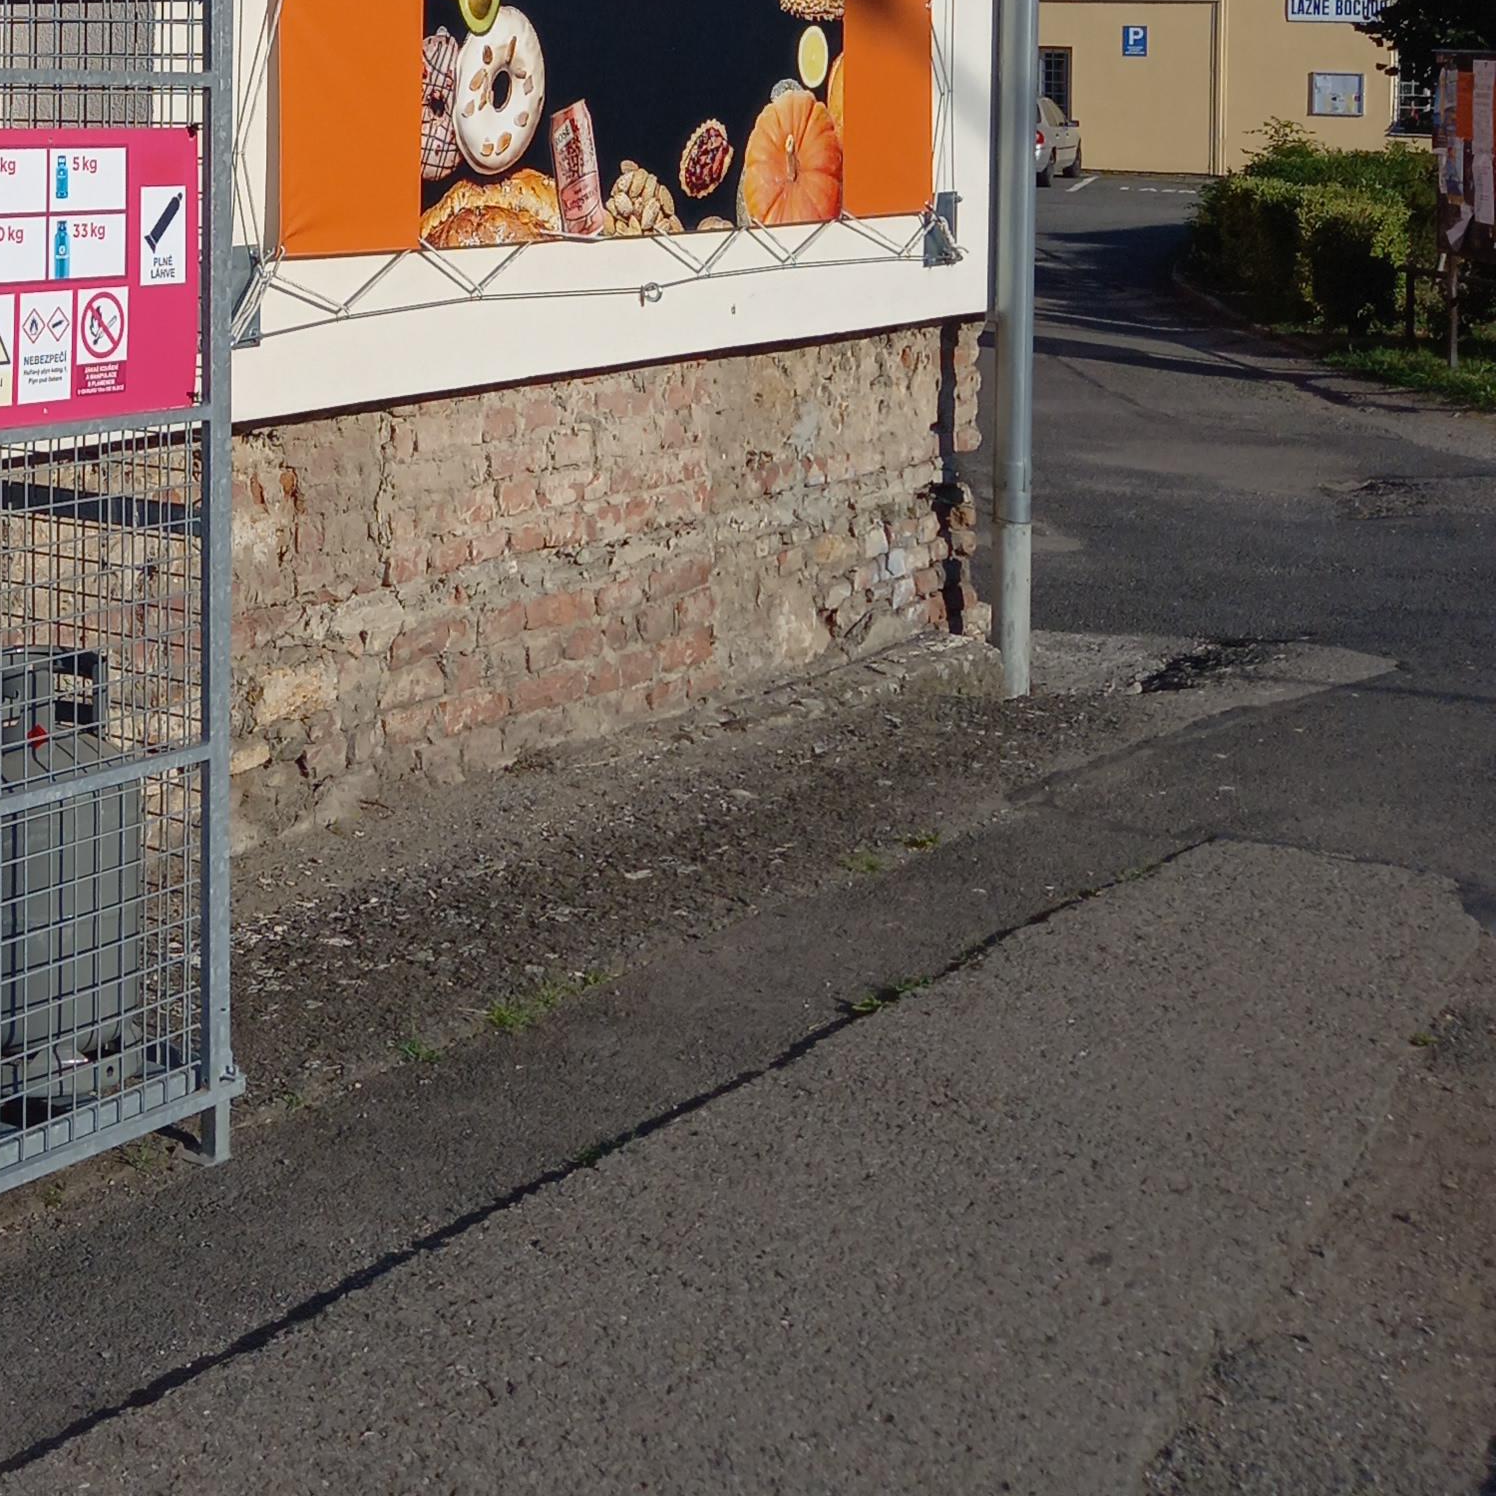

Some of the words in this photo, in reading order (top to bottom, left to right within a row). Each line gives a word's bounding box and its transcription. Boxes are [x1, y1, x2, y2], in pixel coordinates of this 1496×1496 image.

[1129, 27, 1144, 45] P
[0, 156, 16, 174] kg
[72, 157, 80, 171] 5
[82, 156, 97, 173] kg
[8, 226, 24, 244] kg
[73, 224, 89, 238] 33
[90, 222, 106, 240] kg
[23, 350, 67, 366] NEBEZPEČÍ
